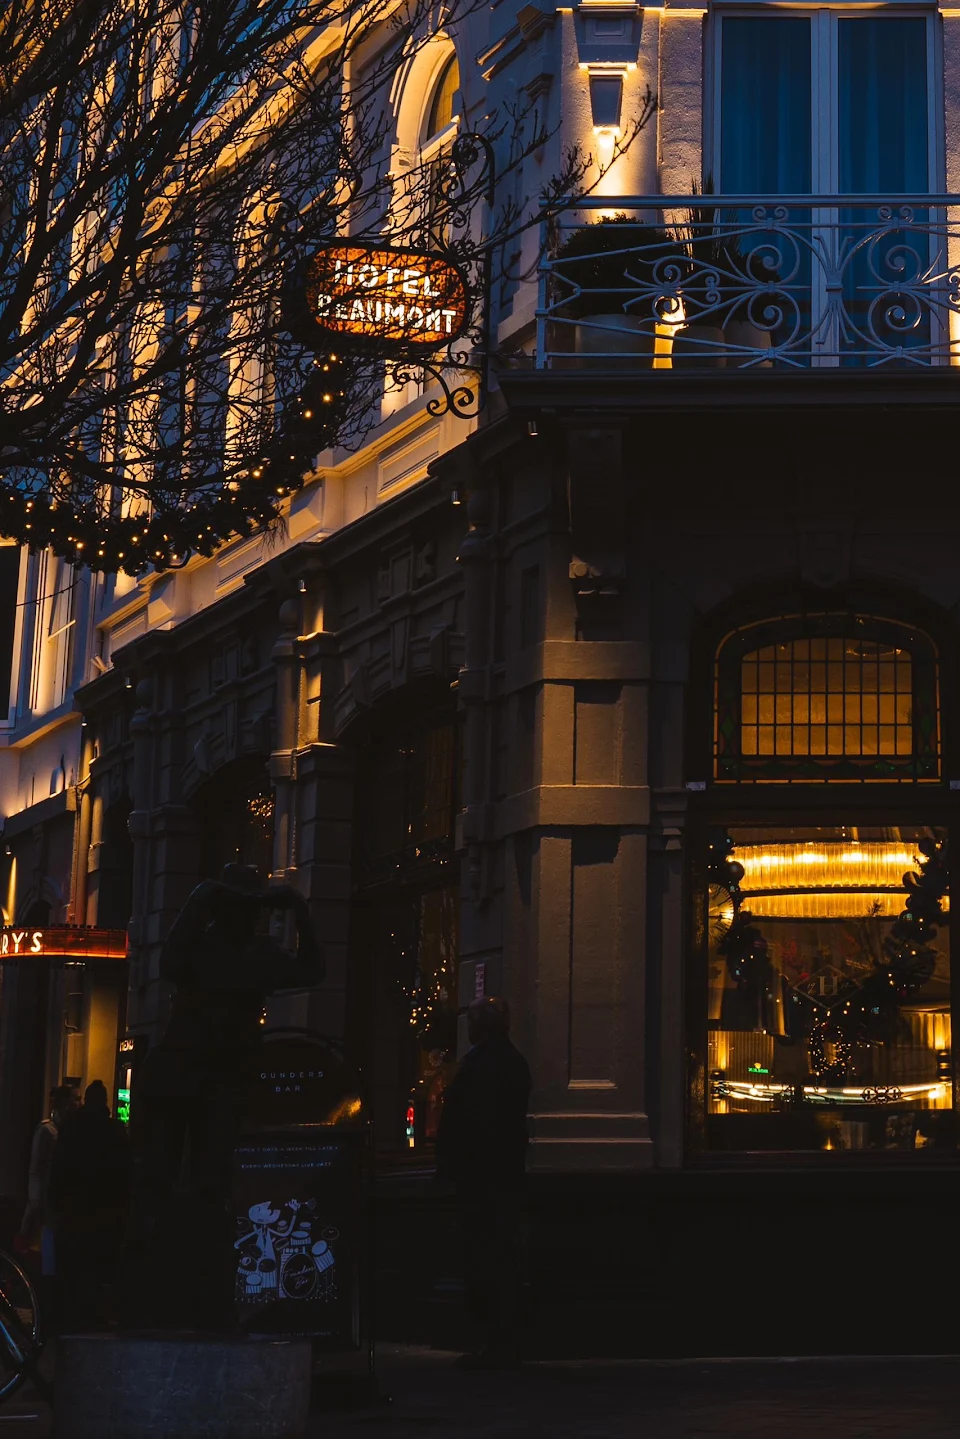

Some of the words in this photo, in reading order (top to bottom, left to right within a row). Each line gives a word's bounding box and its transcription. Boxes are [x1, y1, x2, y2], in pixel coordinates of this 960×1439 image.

[335, 259, 441, 297] HOTEL
[317, 293, 457, 333] BEAUMONT
[0, 931, 43, 955] RY'S
[817, 975, 840, 997] H
[260, 1071, 324, 1080] OUNDERS
[294, 1275, 308, 1290] Bar
